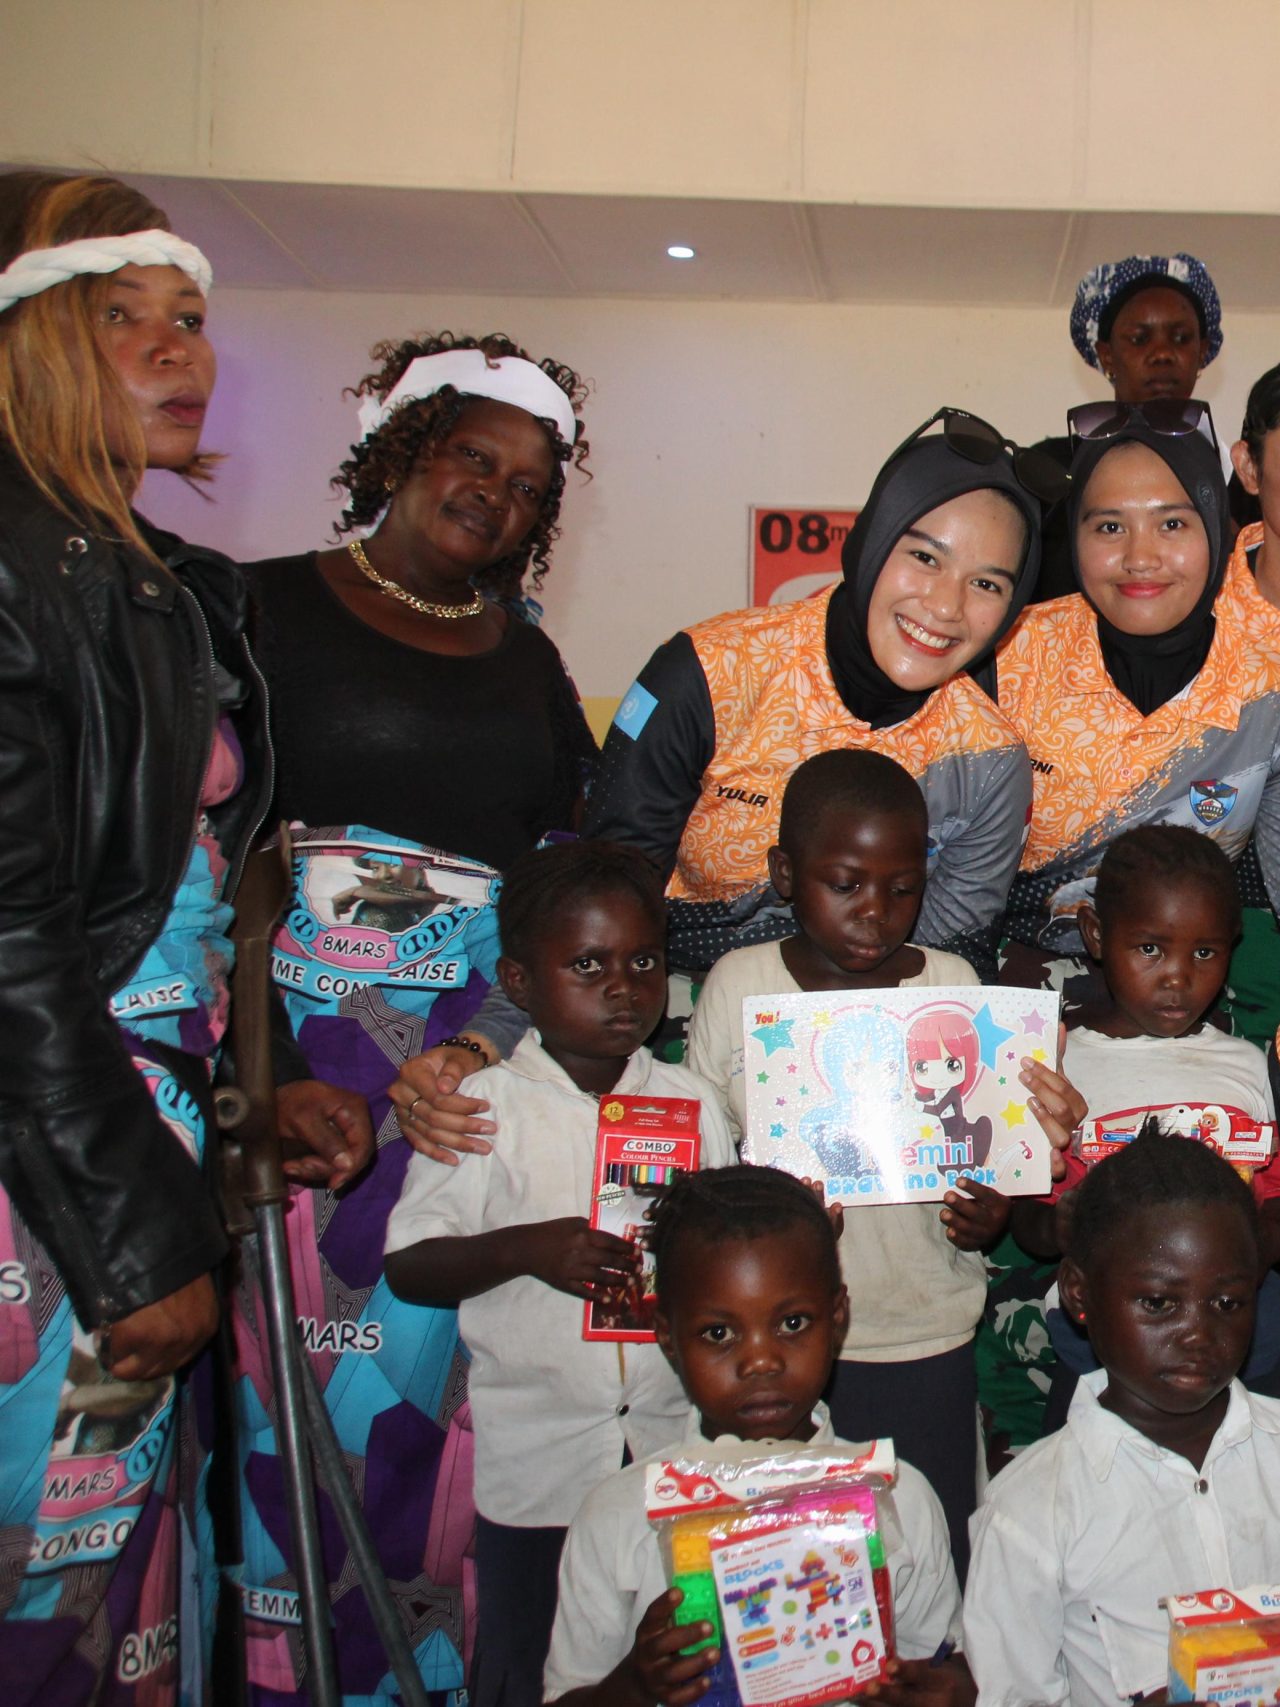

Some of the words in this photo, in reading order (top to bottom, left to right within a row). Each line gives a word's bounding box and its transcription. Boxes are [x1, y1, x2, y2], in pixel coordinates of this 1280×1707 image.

[717, 785, 769, 807] YULIA
[322, 935, 388, 959] 8MARS
[626, 1140, 672, 1153] COMBO
